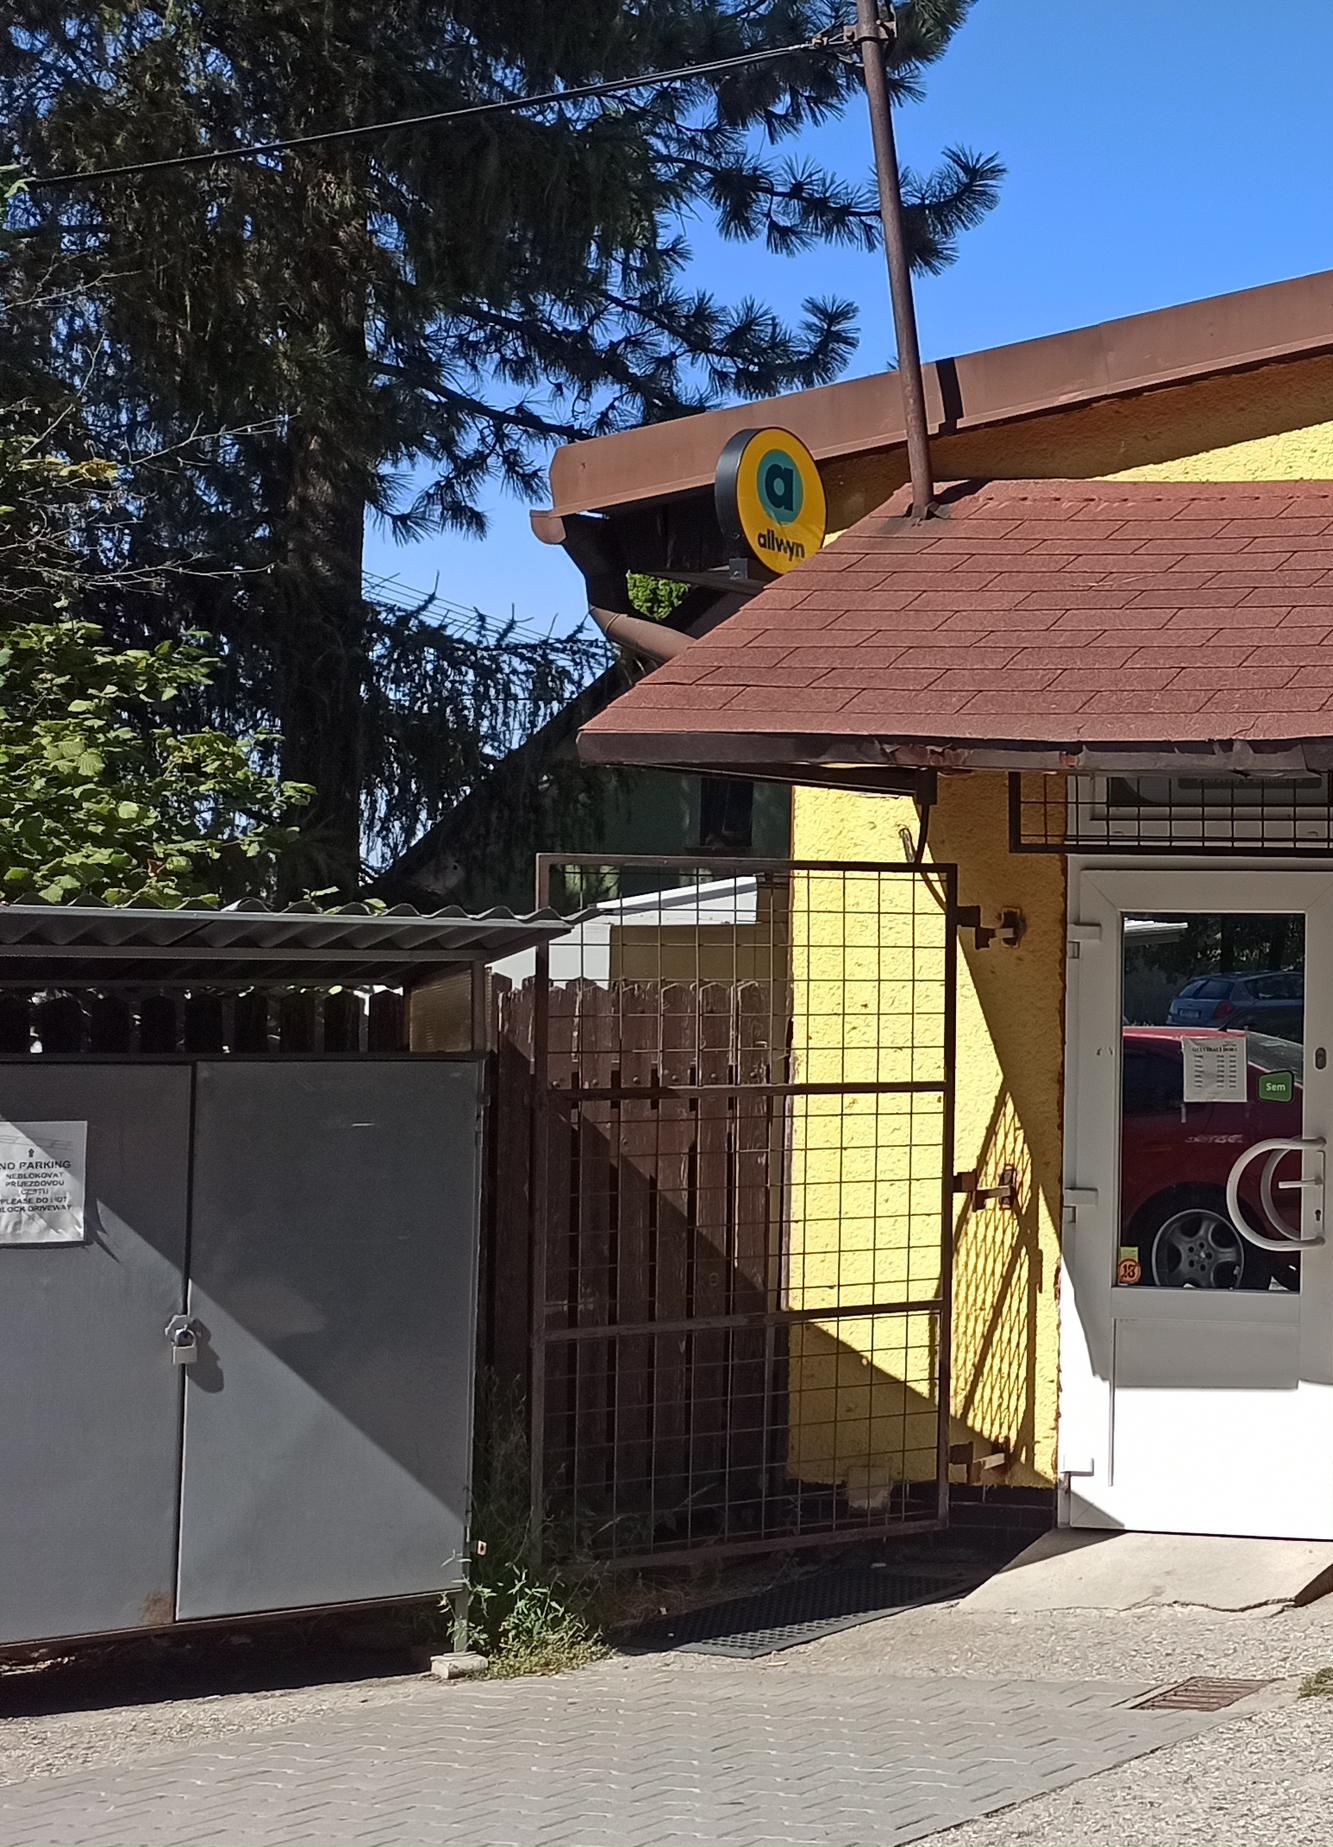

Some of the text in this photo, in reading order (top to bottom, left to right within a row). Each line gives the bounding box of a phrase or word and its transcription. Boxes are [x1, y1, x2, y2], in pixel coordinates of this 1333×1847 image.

[757, 529, 806, 562] allwyn
[1265, 1082, 1286, 1092] Sem
[19, 1160, 72, 1169] PARKING
